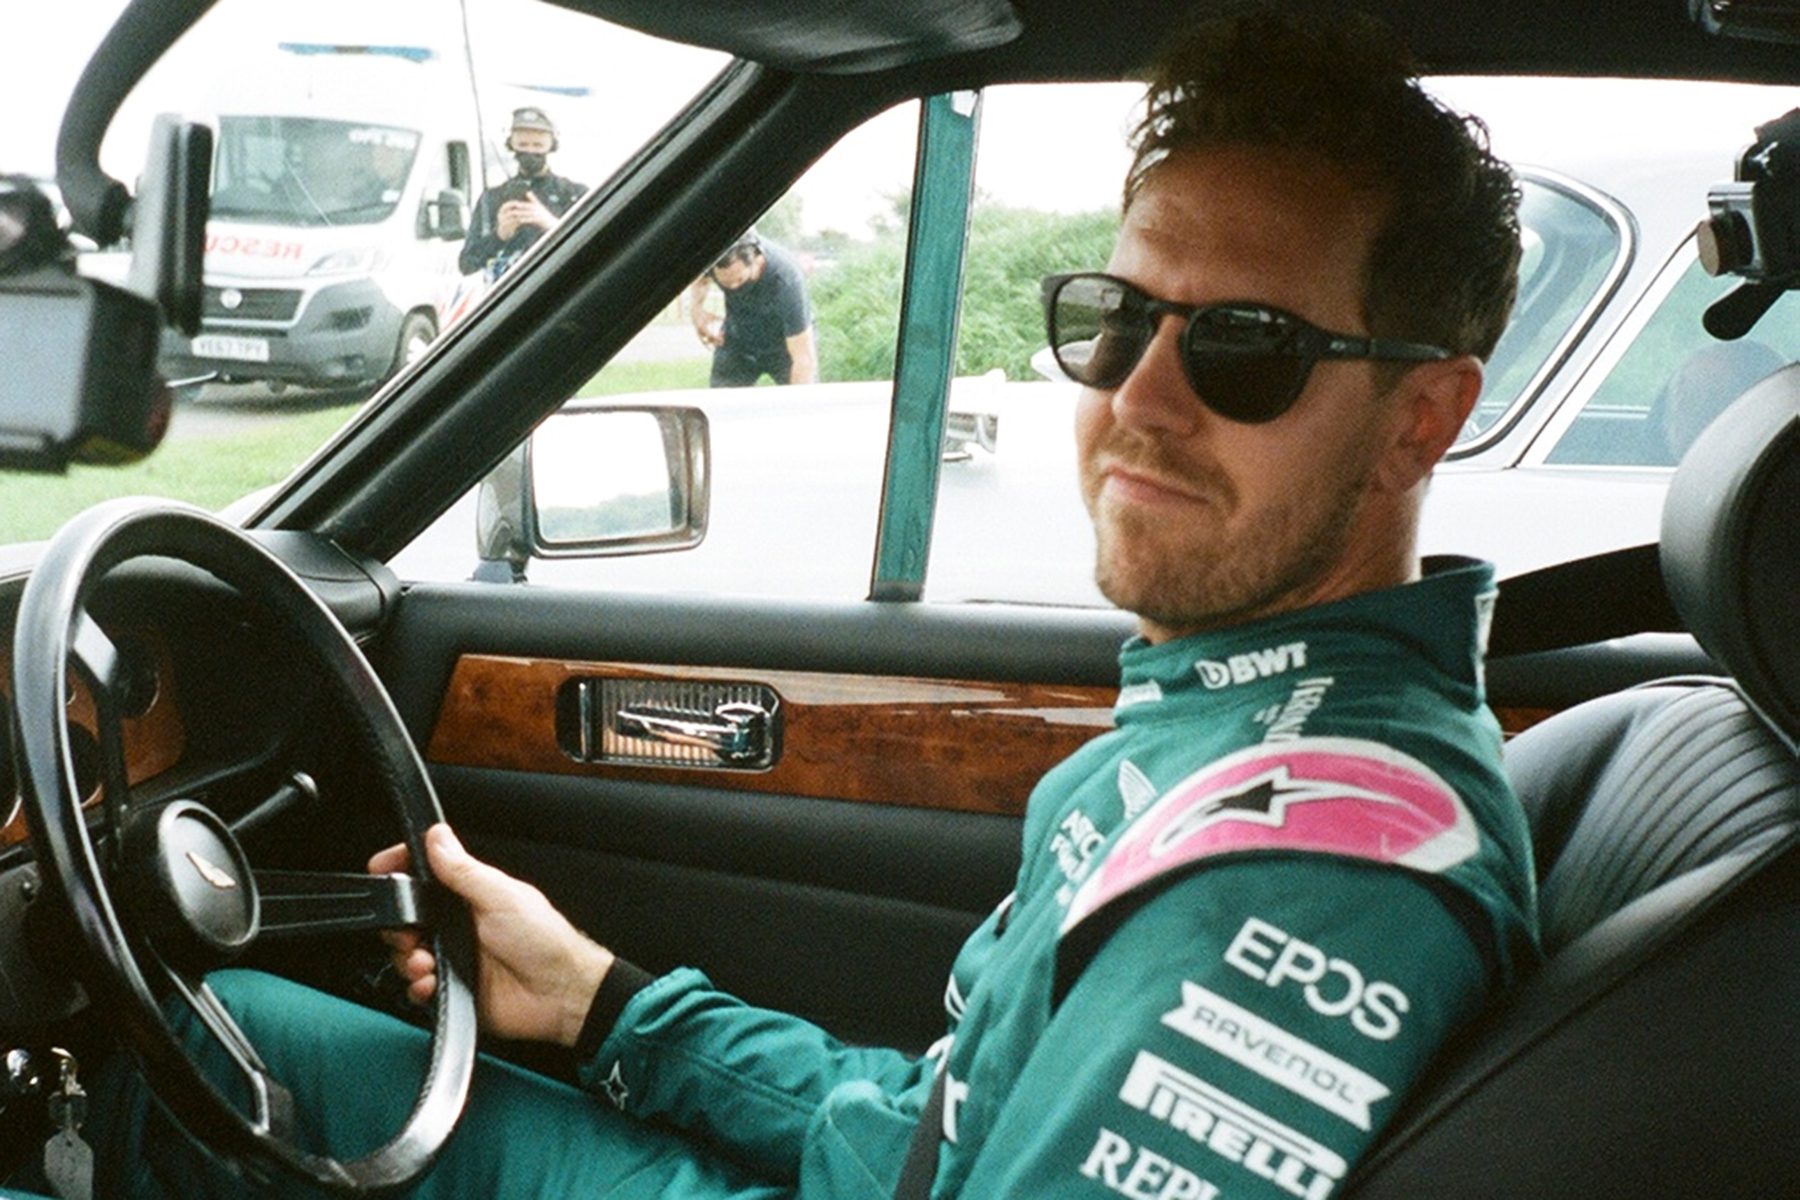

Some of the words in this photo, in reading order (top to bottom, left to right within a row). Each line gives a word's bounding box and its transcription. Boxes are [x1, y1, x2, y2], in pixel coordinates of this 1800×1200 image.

[1228, 641, 1307, 685] BWT
[1223, 916, 1411, 1041] EPOS
[1192, 1004, 1358, 1106] RAVENOL
[1118, 1049, 1348, 1200] PIRELLI
